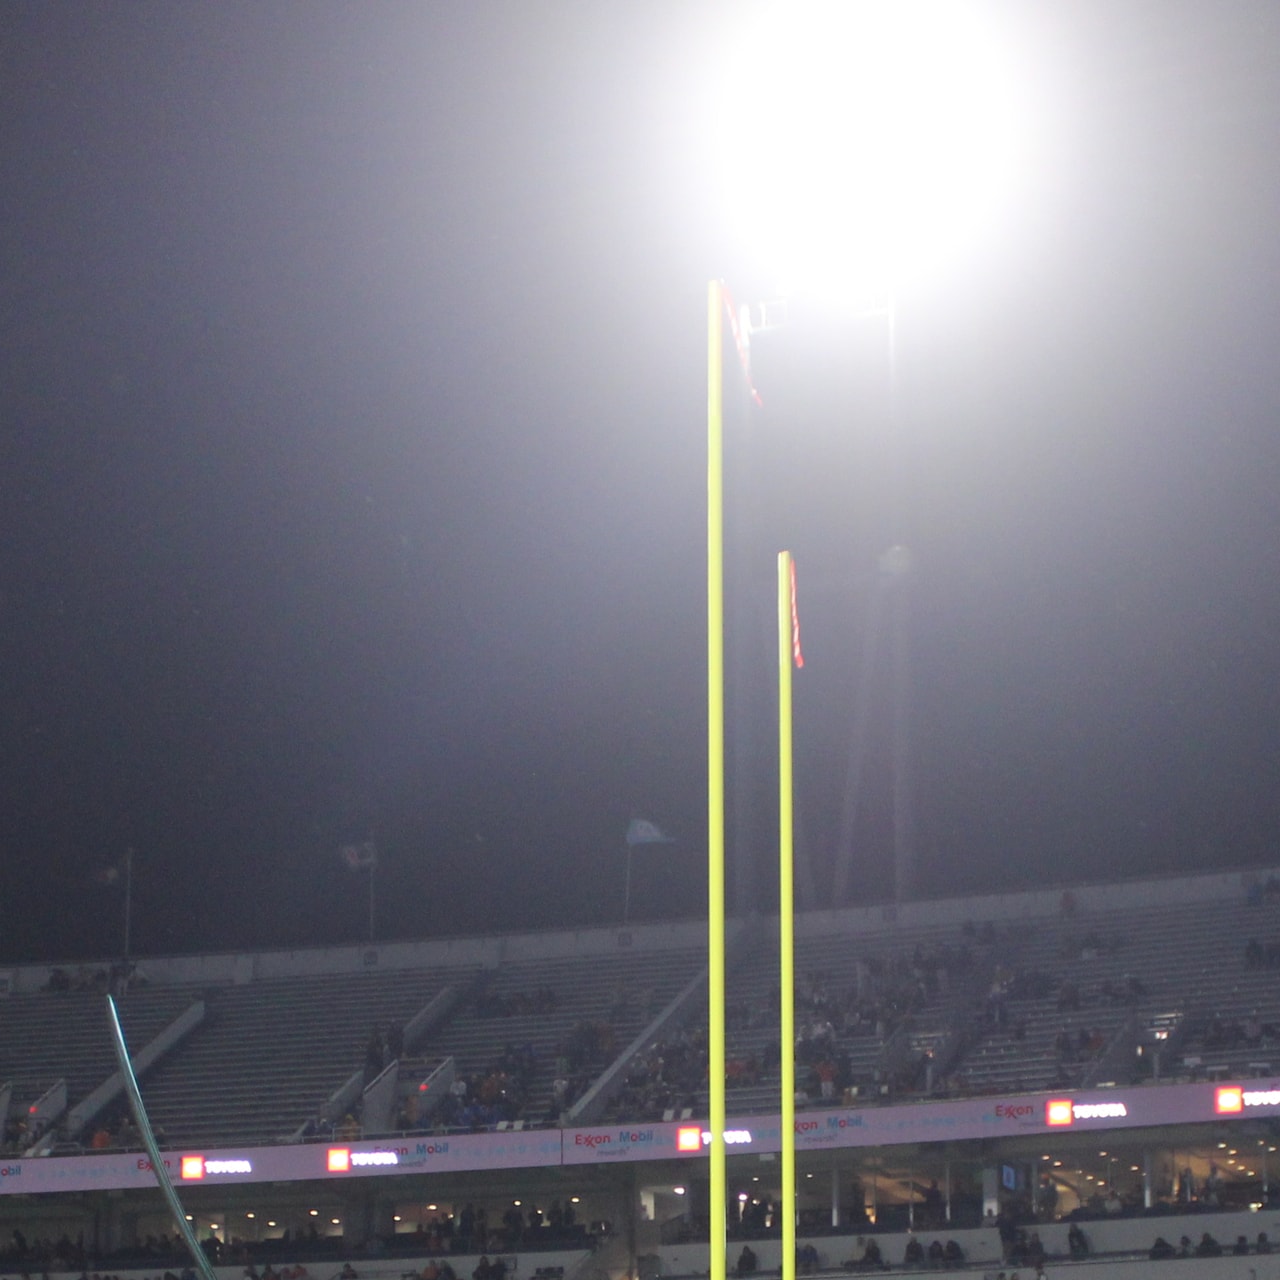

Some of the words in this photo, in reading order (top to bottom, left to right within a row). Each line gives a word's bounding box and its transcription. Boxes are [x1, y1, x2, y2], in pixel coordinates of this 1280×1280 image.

[1072, 1103, 1126, 1118] TOYOTA
[575, 1134, 610, 1148] Exxon
[619, 1130, 653, 1142] Mobil
[350, 1152, 398, 1165] TOYOTA
[205, 1160, 251, 1173] TOYOTA
